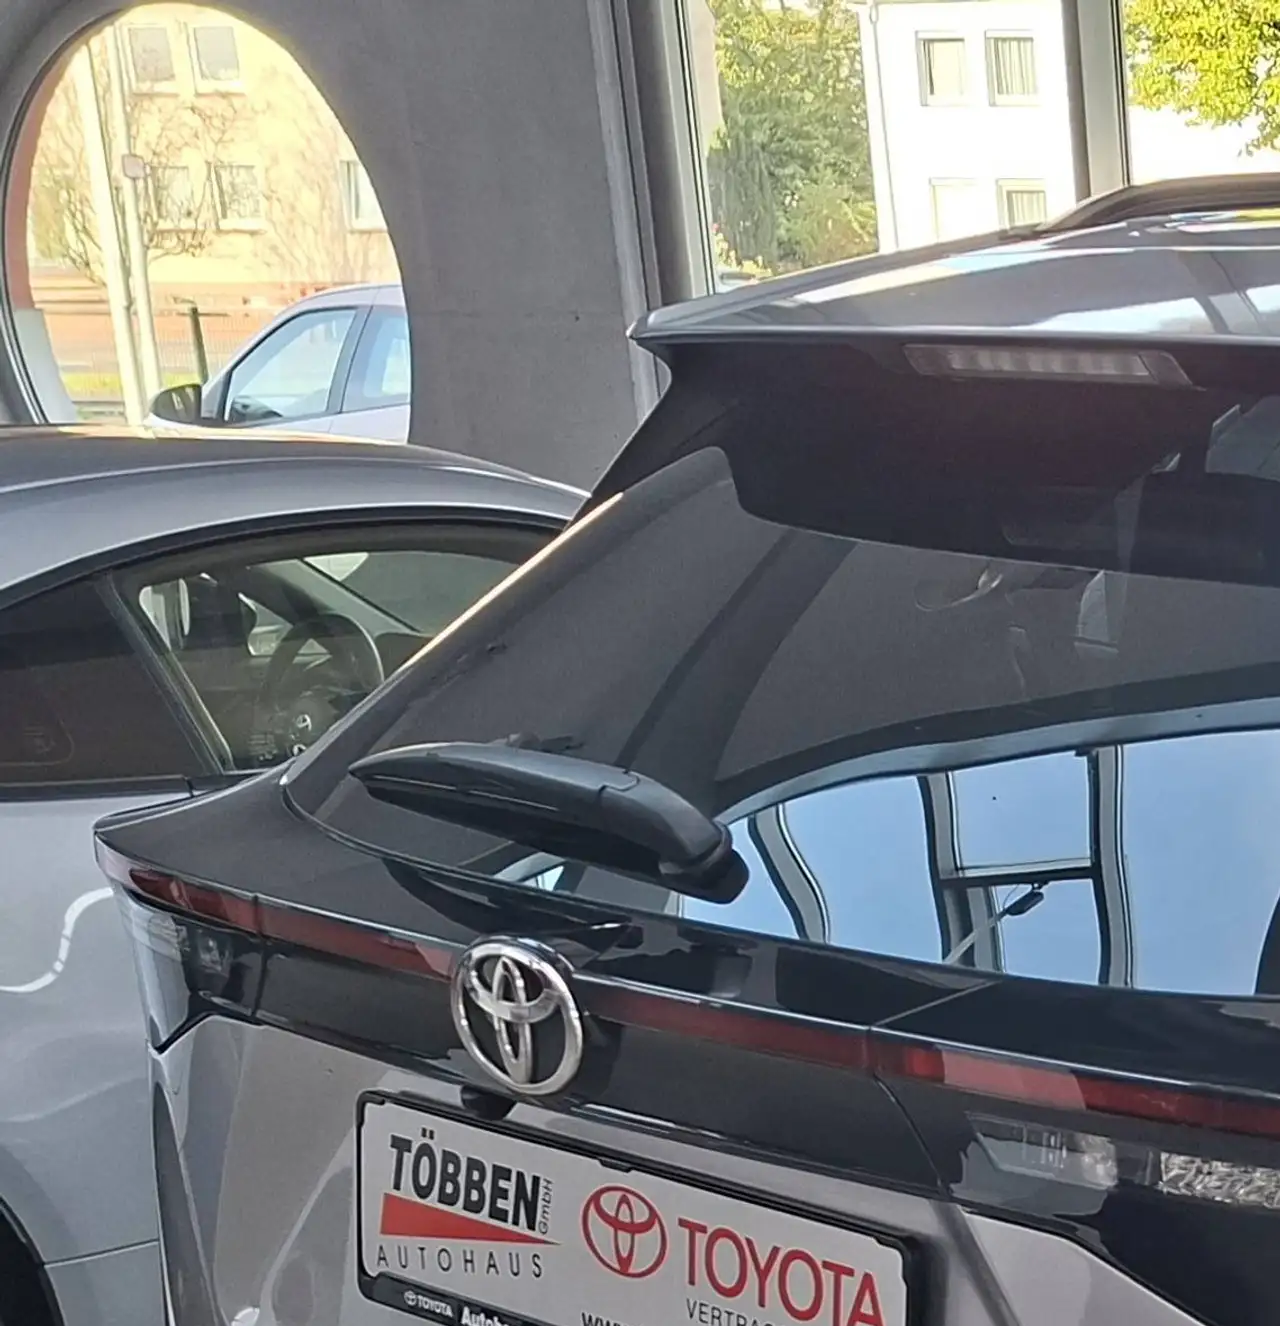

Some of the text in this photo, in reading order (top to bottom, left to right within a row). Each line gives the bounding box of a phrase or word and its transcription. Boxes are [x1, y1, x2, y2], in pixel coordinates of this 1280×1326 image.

[388, 1127, 553, 1235] TÖBBEN GmbH
[376, 1244, 543, 1278] AUTOHAUS
[417, 1293, 453, 1318] TOYOTA
